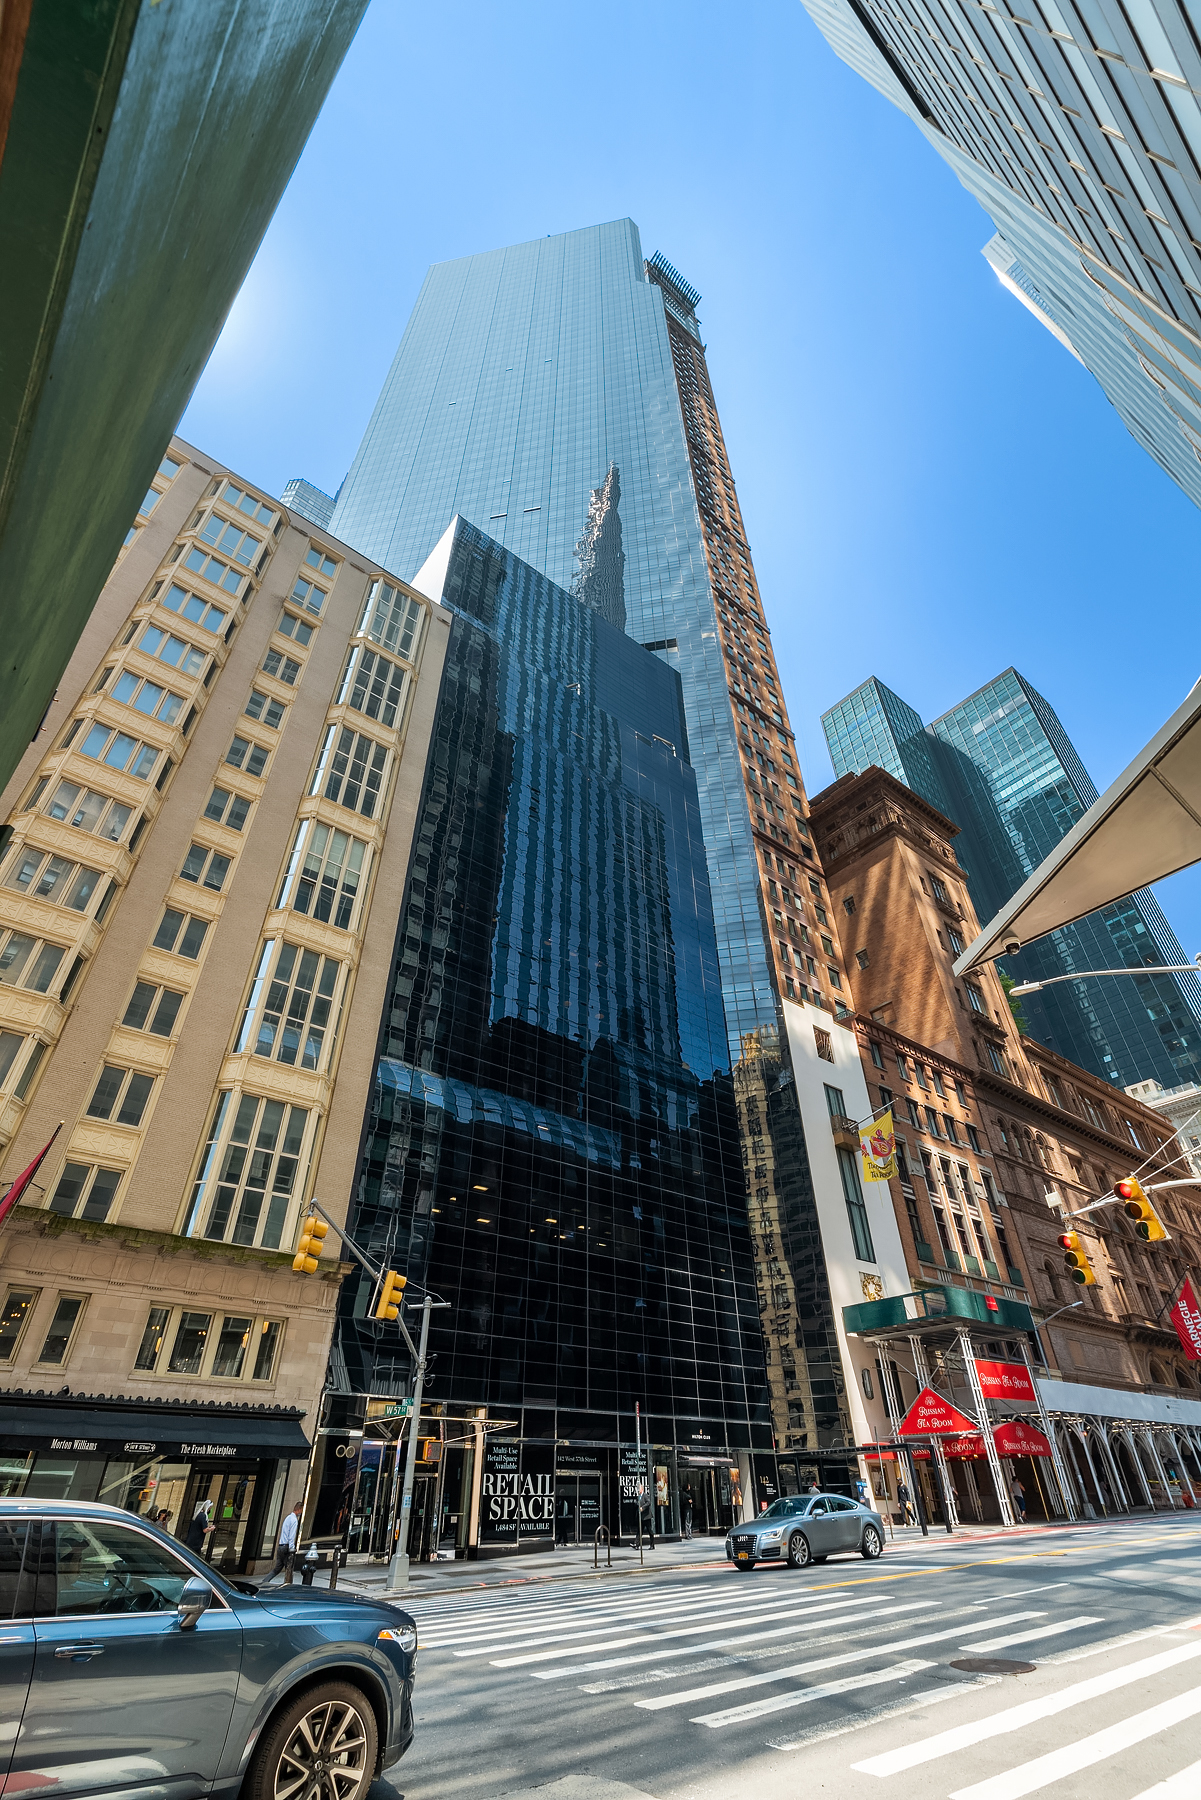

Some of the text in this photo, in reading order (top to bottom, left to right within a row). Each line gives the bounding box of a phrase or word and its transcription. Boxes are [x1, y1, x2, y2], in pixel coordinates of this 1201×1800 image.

[1002, 1375, 1013, 1387] TEA
[393, 1406, 401, 1415] 57
[918, 1406, 946, 1417] RUSSIAN
[917, 1418, 953, 1429] TEA ROOM
[50, 1438, 98, 1450] Morton Williams
[180, 1443, 236, 1456] The Fresh Marketplace
[951, 1442, 975, 1453] ROOM
[482, 1473, 555, 1496] RETAIL
[489, 1496, 554, 1520] SPACE
[518, 1522, 550, 1531] AVAILABLE
